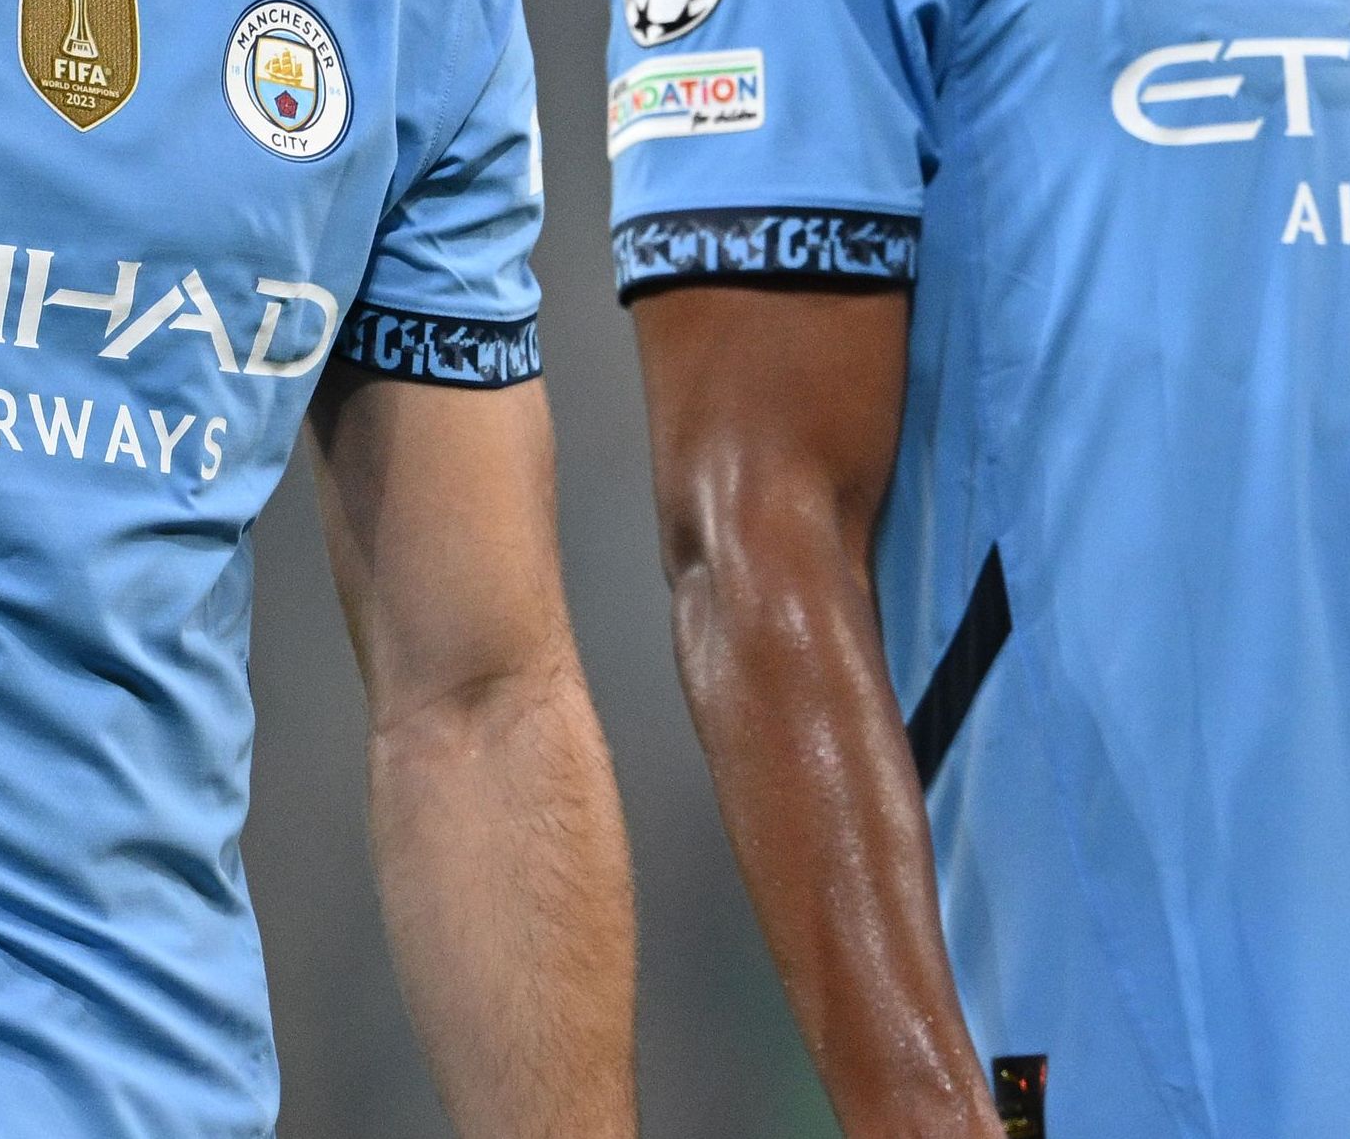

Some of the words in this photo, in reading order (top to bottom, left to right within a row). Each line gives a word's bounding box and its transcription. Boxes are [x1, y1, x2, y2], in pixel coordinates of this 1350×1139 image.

[237, 9, 334, 70] MANCHESTER
[54, 58, 108, 87] FIFA
[40, 79, 71, 91] WORLD
[71, 83, 120, 99] CHAMPIONS
[65, 92, 96, 109] 2023
[271, 133, 309, 152] CITY
